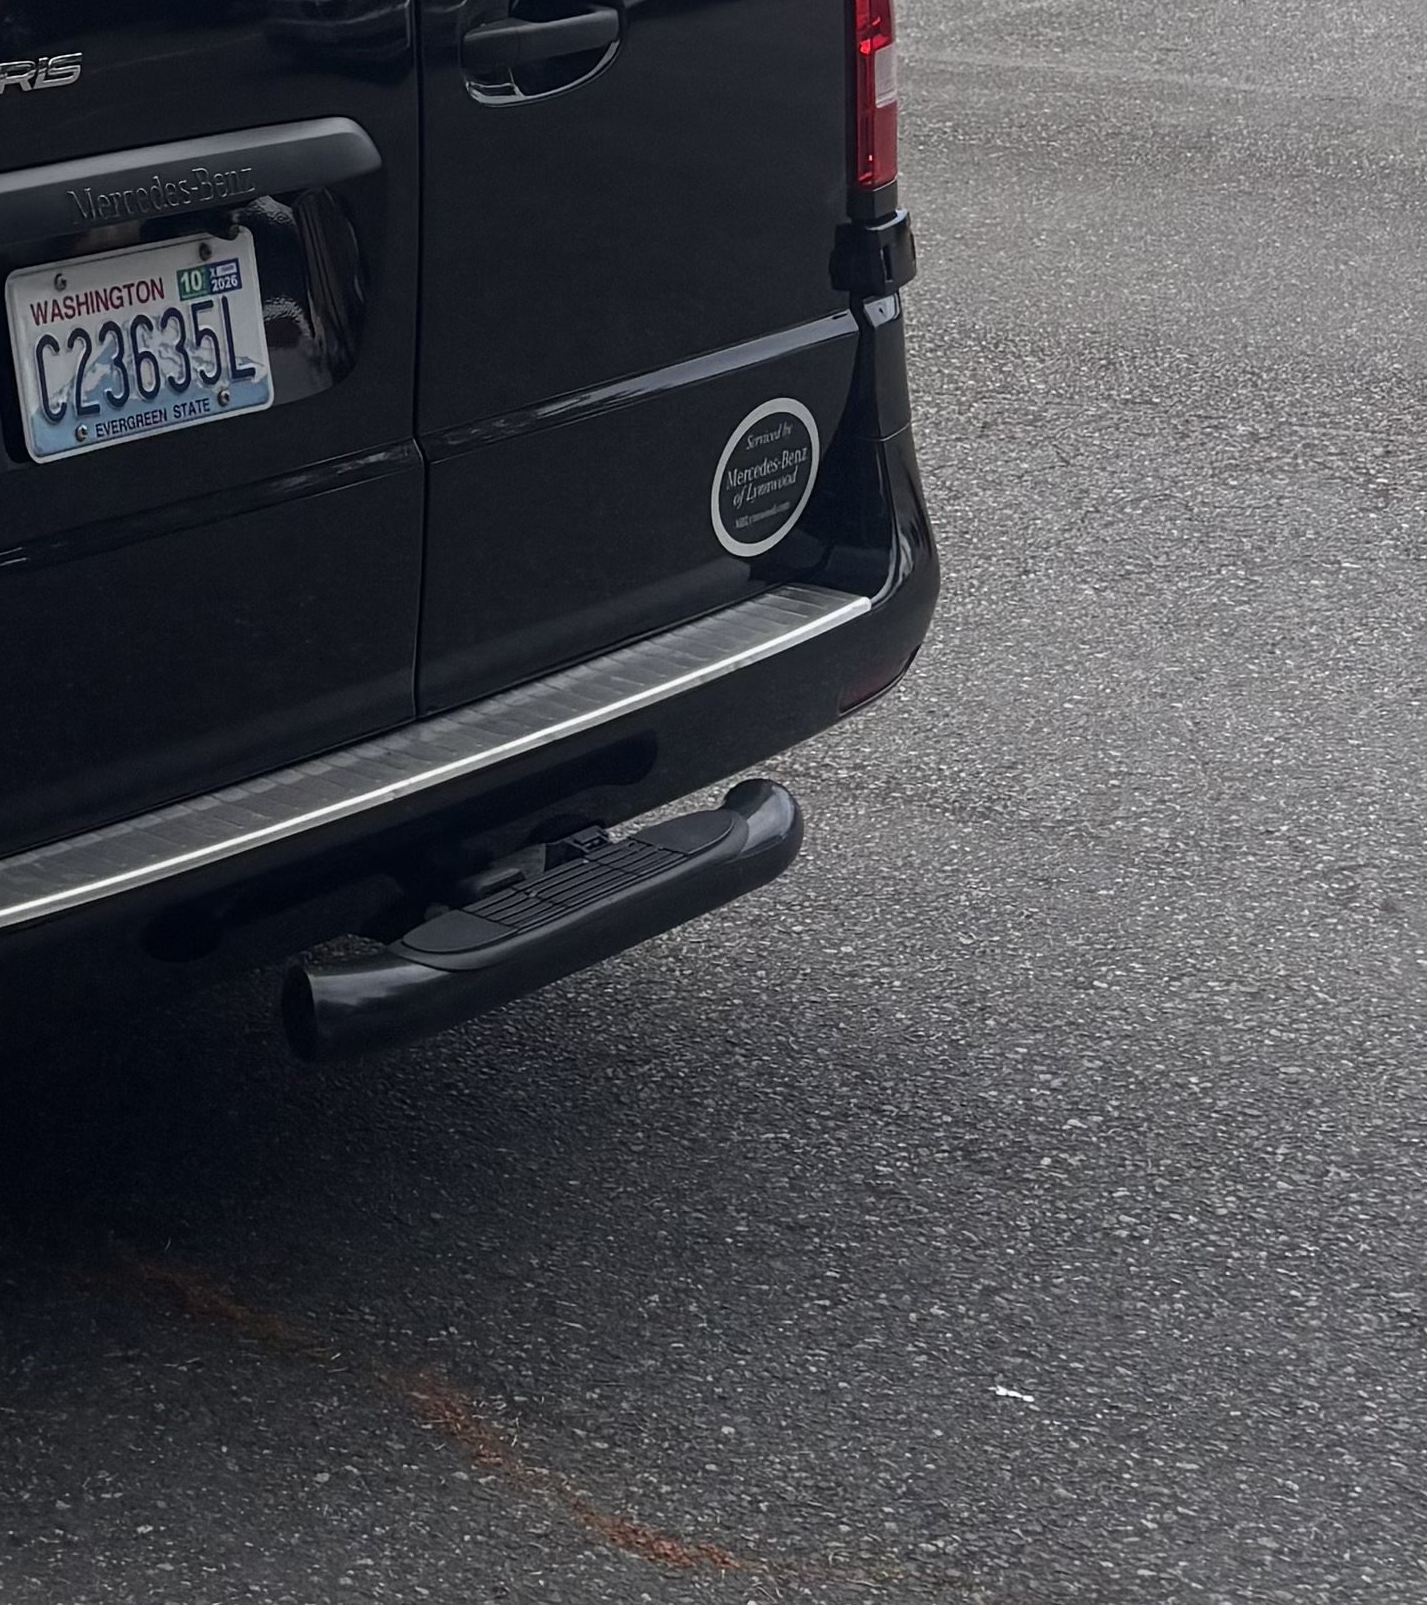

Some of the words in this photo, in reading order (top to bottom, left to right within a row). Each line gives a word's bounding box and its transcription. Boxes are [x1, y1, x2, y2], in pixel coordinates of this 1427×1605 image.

[67, 167, 256, 224] Mercedes-Benz
[29, 277, 166, 327] WASHINGTON
[180, 270, 203, 293] 10
[211, 275, 238, 292] 2026
[35, 295, 257, 425] C23635L
[95, 408, 168, 438] EVERGREEN
[173, 398, 211, 419] STATE
[726, 447, 808, 490] Mercedes-Benz
